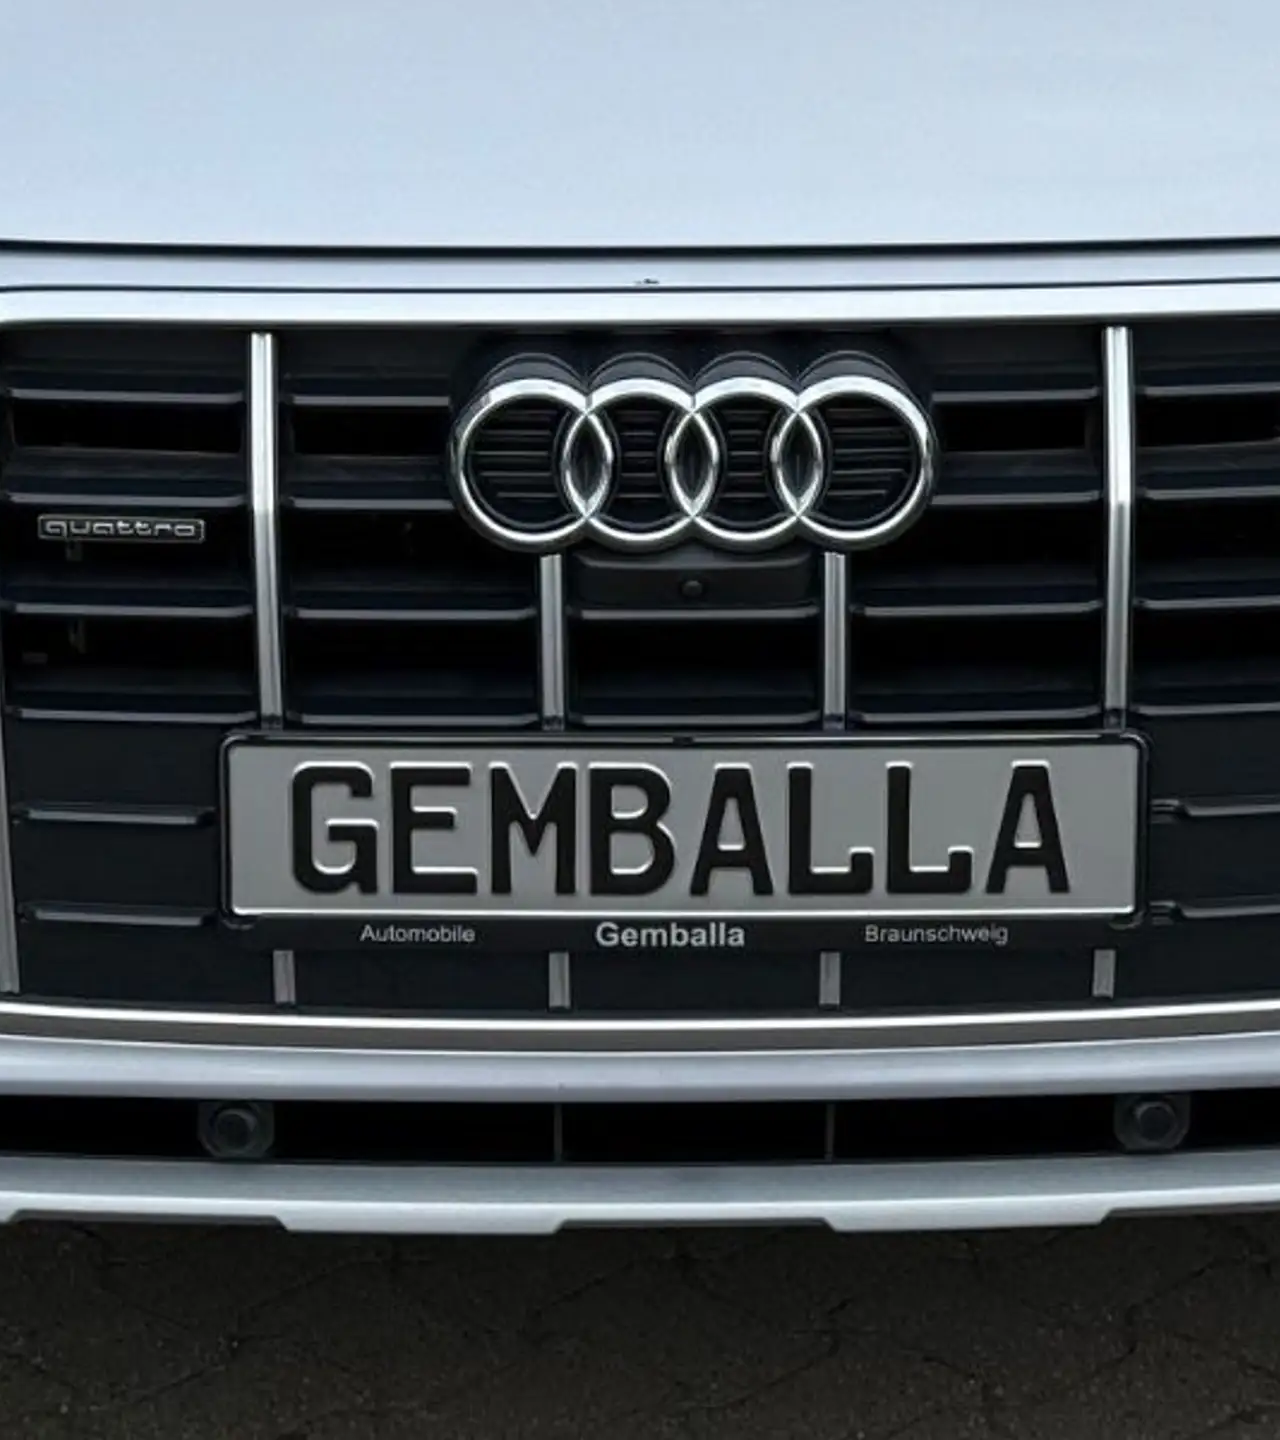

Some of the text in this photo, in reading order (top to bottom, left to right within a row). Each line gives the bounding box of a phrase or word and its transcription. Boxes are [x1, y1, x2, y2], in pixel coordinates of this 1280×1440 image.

[45, 520, 196, 537] quattro
[290, 762, 1071, 897] GEMBALLA
[360, 921, 1008, 947] Automobile Gemballa Braunschweig
